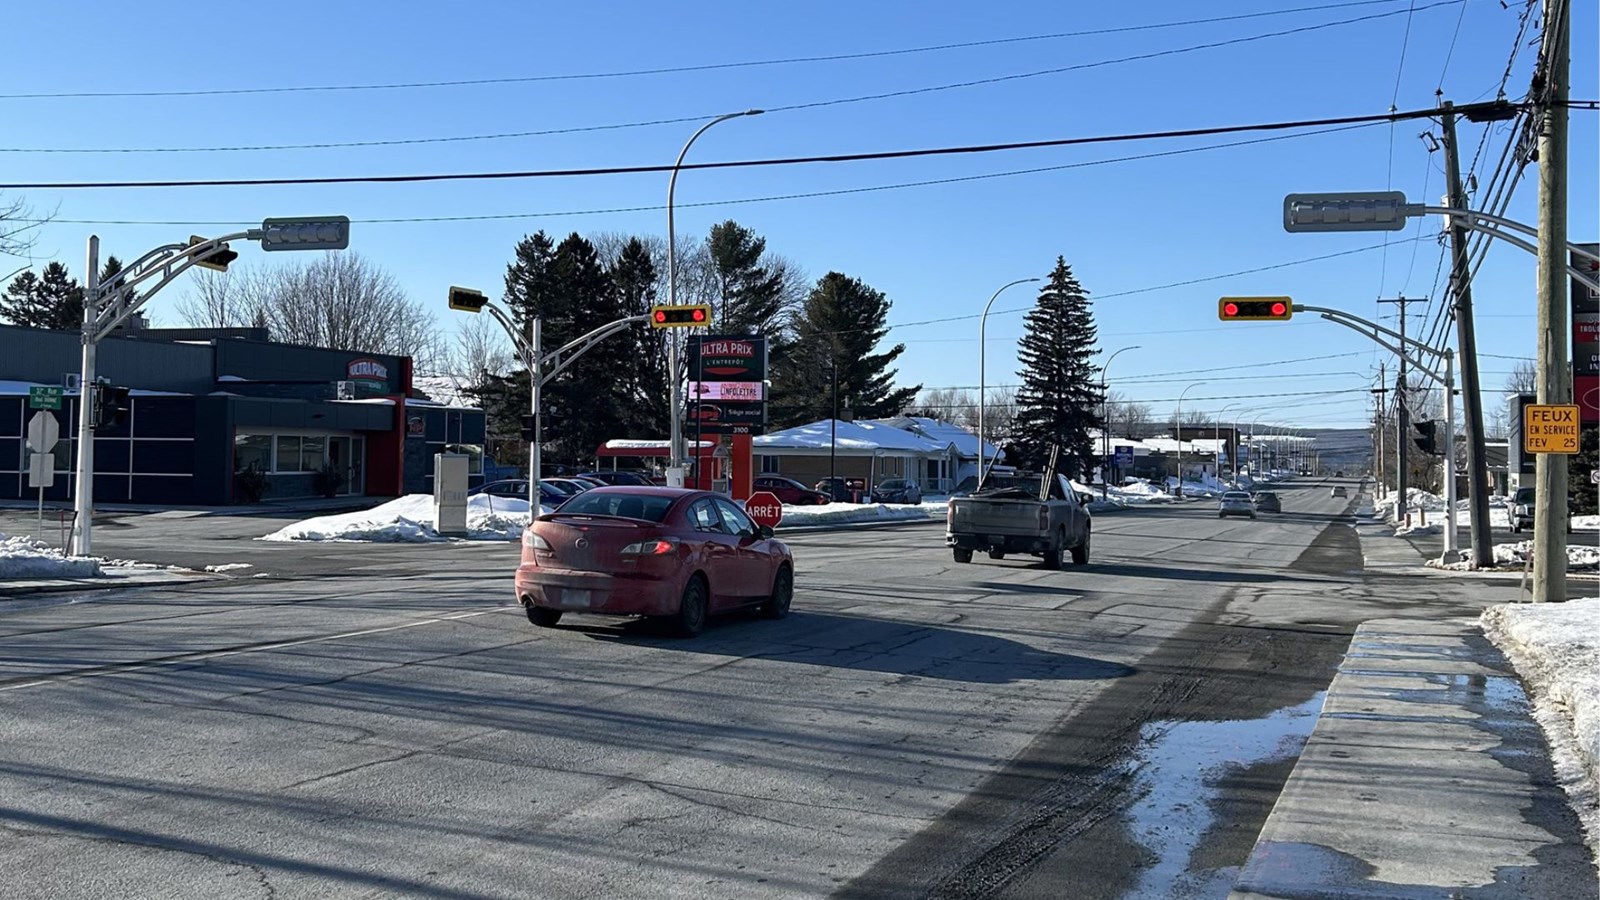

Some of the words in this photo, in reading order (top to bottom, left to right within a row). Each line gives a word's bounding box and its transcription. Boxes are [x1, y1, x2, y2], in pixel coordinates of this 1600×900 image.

[701, 343, 728, 355] ULTRA
[731, 343, 752, 354] PRIX
[1532, 410, 1572, 422] FEUX
[1529, 425, 1540, 435] EN
[1543, 425, 1576, 435] SERVICE
[1529, 438, 1547, 447] FEV
[1563, 438, 1576, 448] 25
[748, 504, 780, 518] ARRÊT
